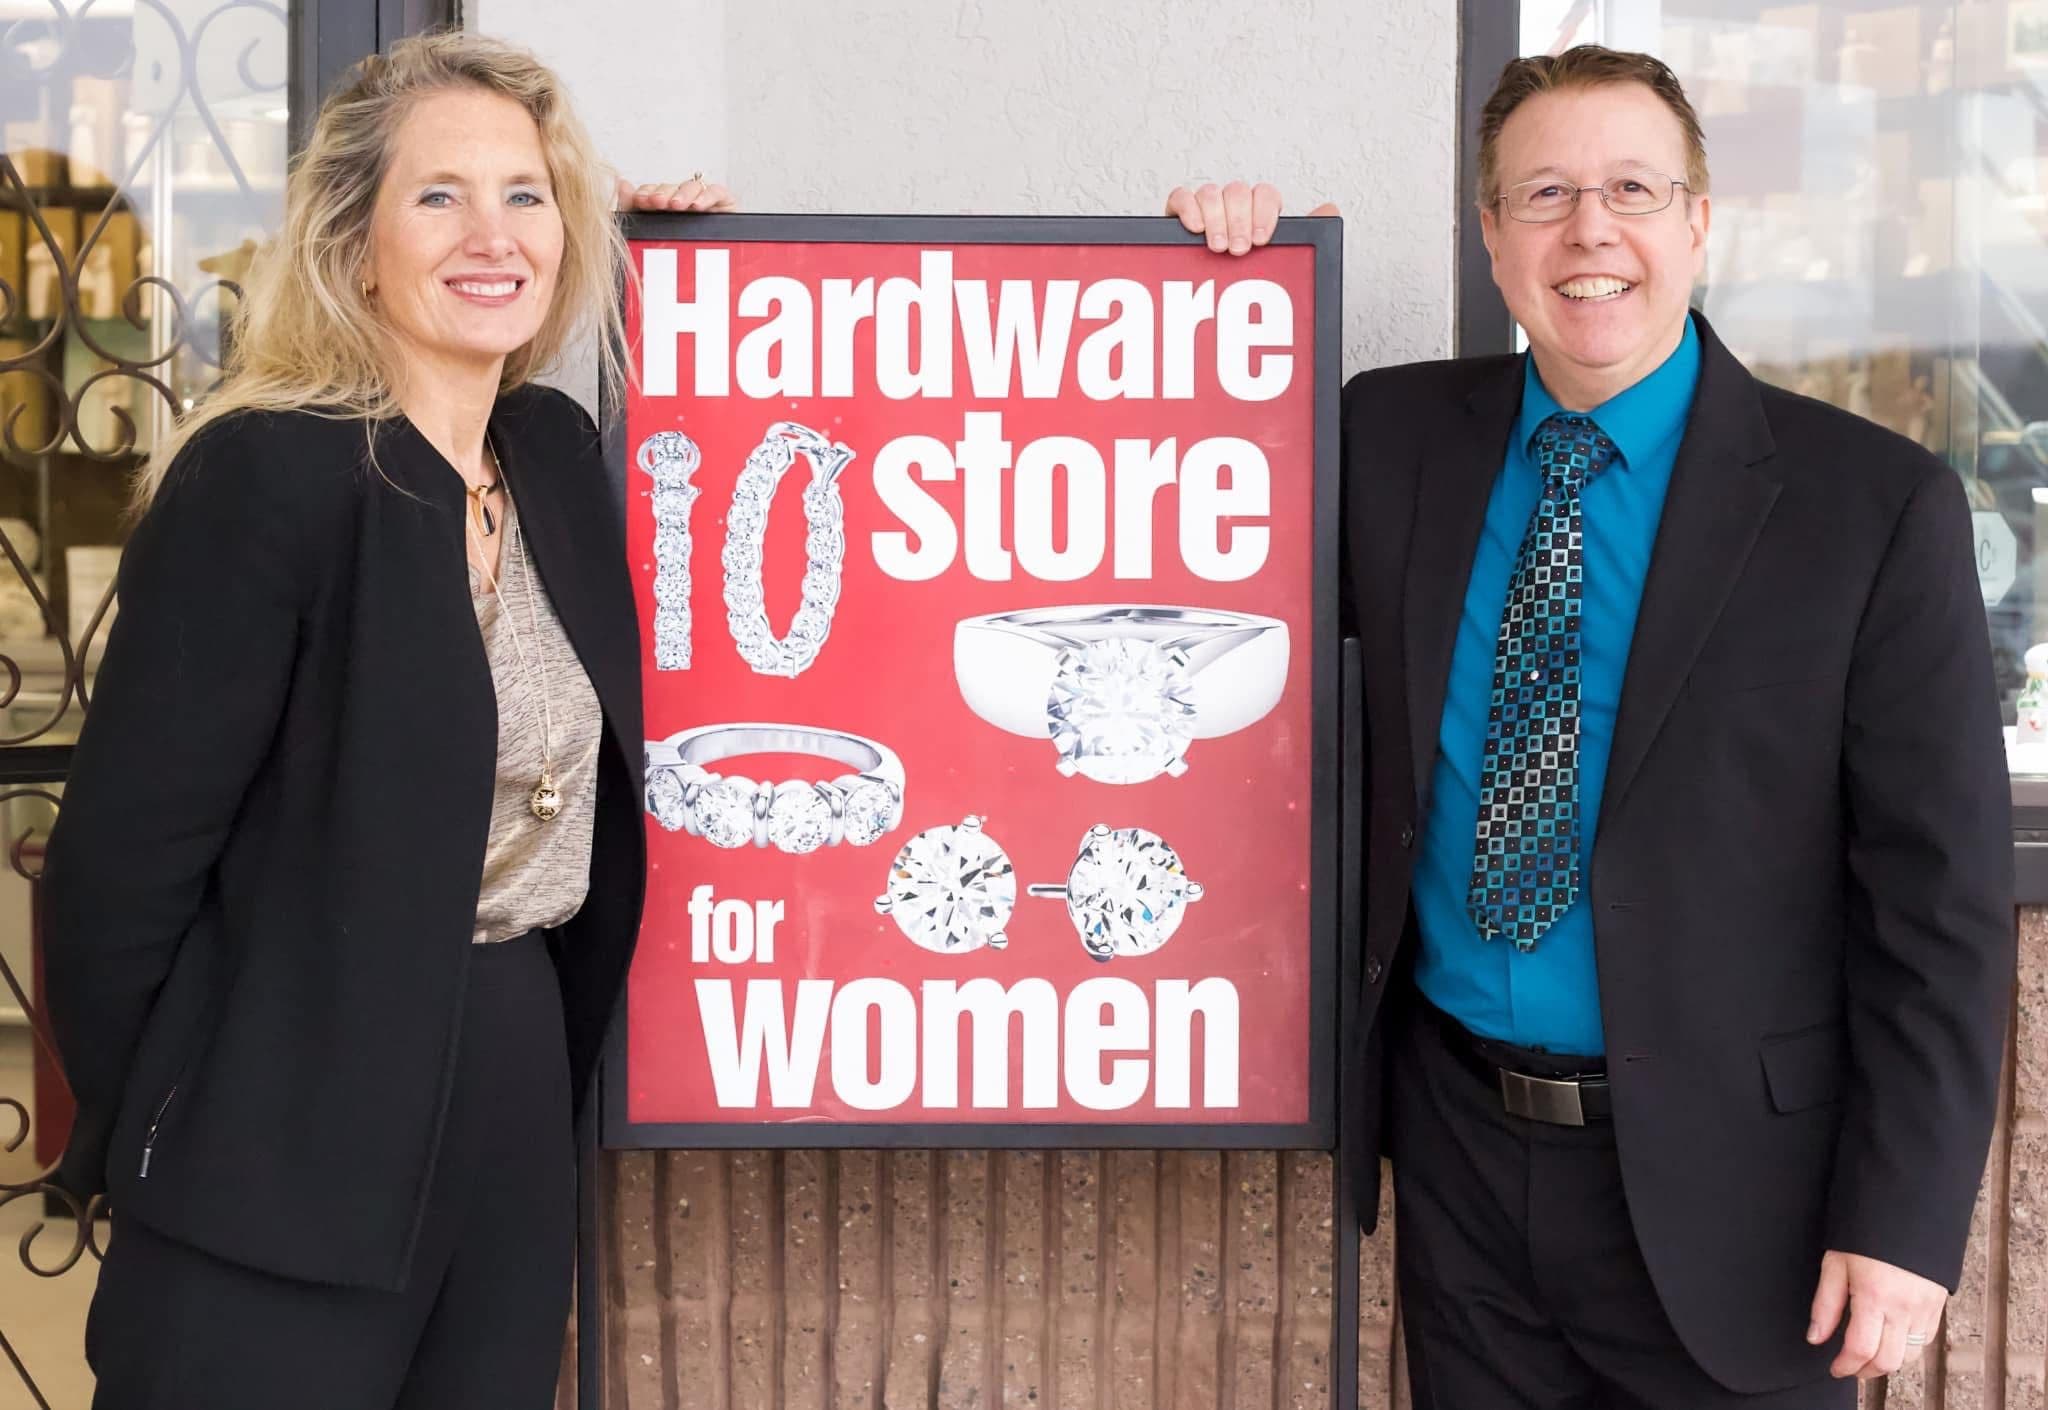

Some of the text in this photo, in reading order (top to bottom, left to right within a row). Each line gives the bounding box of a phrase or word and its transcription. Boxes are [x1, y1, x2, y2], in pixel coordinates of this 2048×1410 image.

[641, 248, 1294, 402] Hardware
[871, 411, 1271, 582] store
[687, 884, 785, 964] for
[694, 976, 1240, 1111] women
